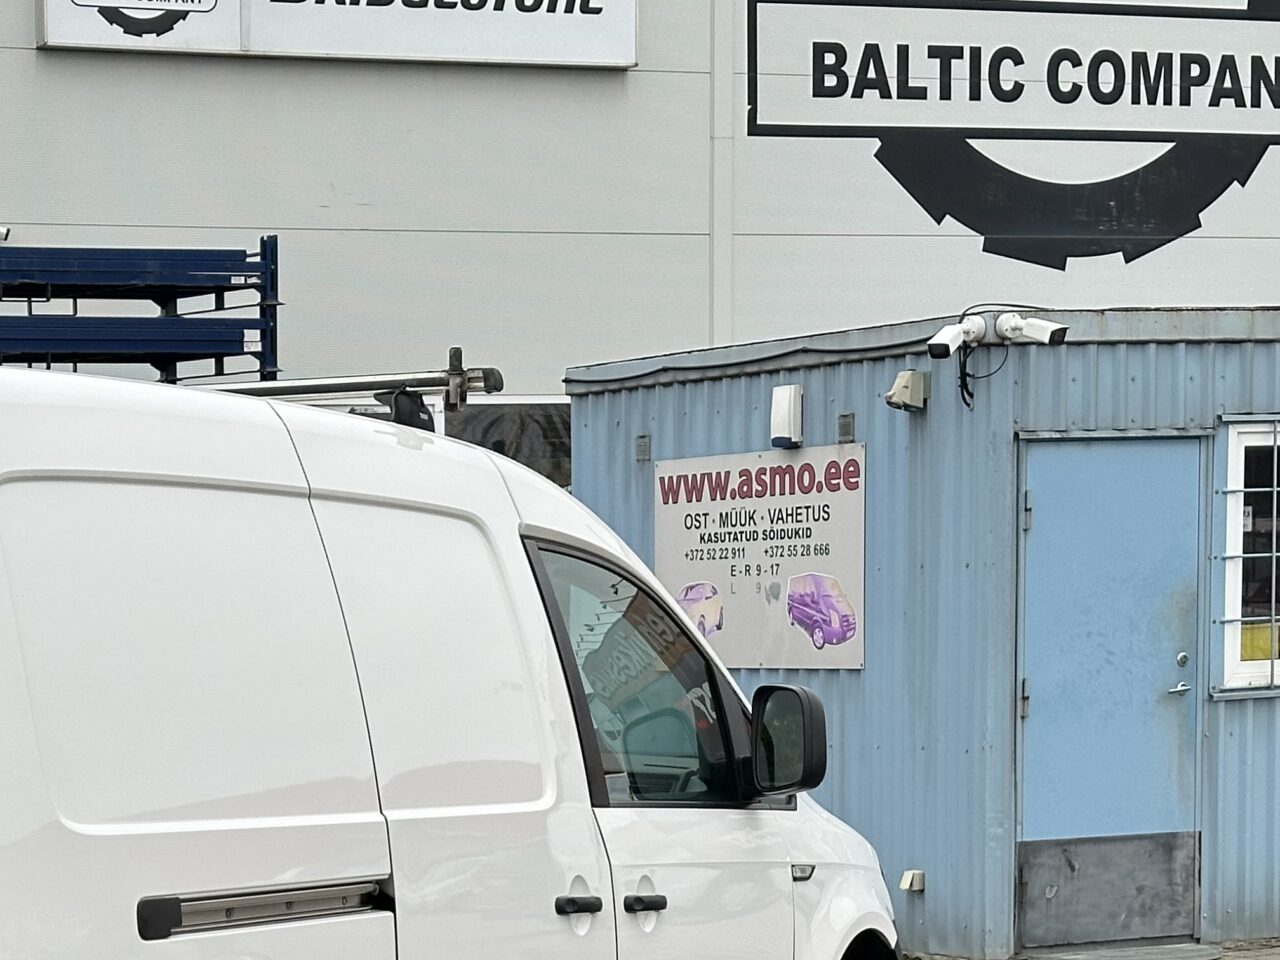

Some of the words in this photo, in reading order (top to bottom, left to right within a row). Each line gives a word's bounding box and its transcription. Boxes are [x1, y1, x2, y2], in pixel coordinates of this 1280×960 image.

[812, 41, 1025, 103] BALTIC
[659, 458, 861, 505] www.asmo.ee
[684, 512, 709, 530] OST
[719, 507, 757, 528] MÜÜK
[768, 504, 830, 525] VAHETUS
[699, 530, 759, 544] KASUTATUD
[762, 526, 812, 541] SÕIDUKID
[684, 548, 704, 561] +372
[706, 548, 717, 560] 52
[718, 547, 729, 560] 22
[731, 547, 745, 560] 911
[763, 545, 785, 558] +372
[787, 544, 798, 557] 55
[800, 544, 811, 557] 28
[813, 543, 830, 556] 666
